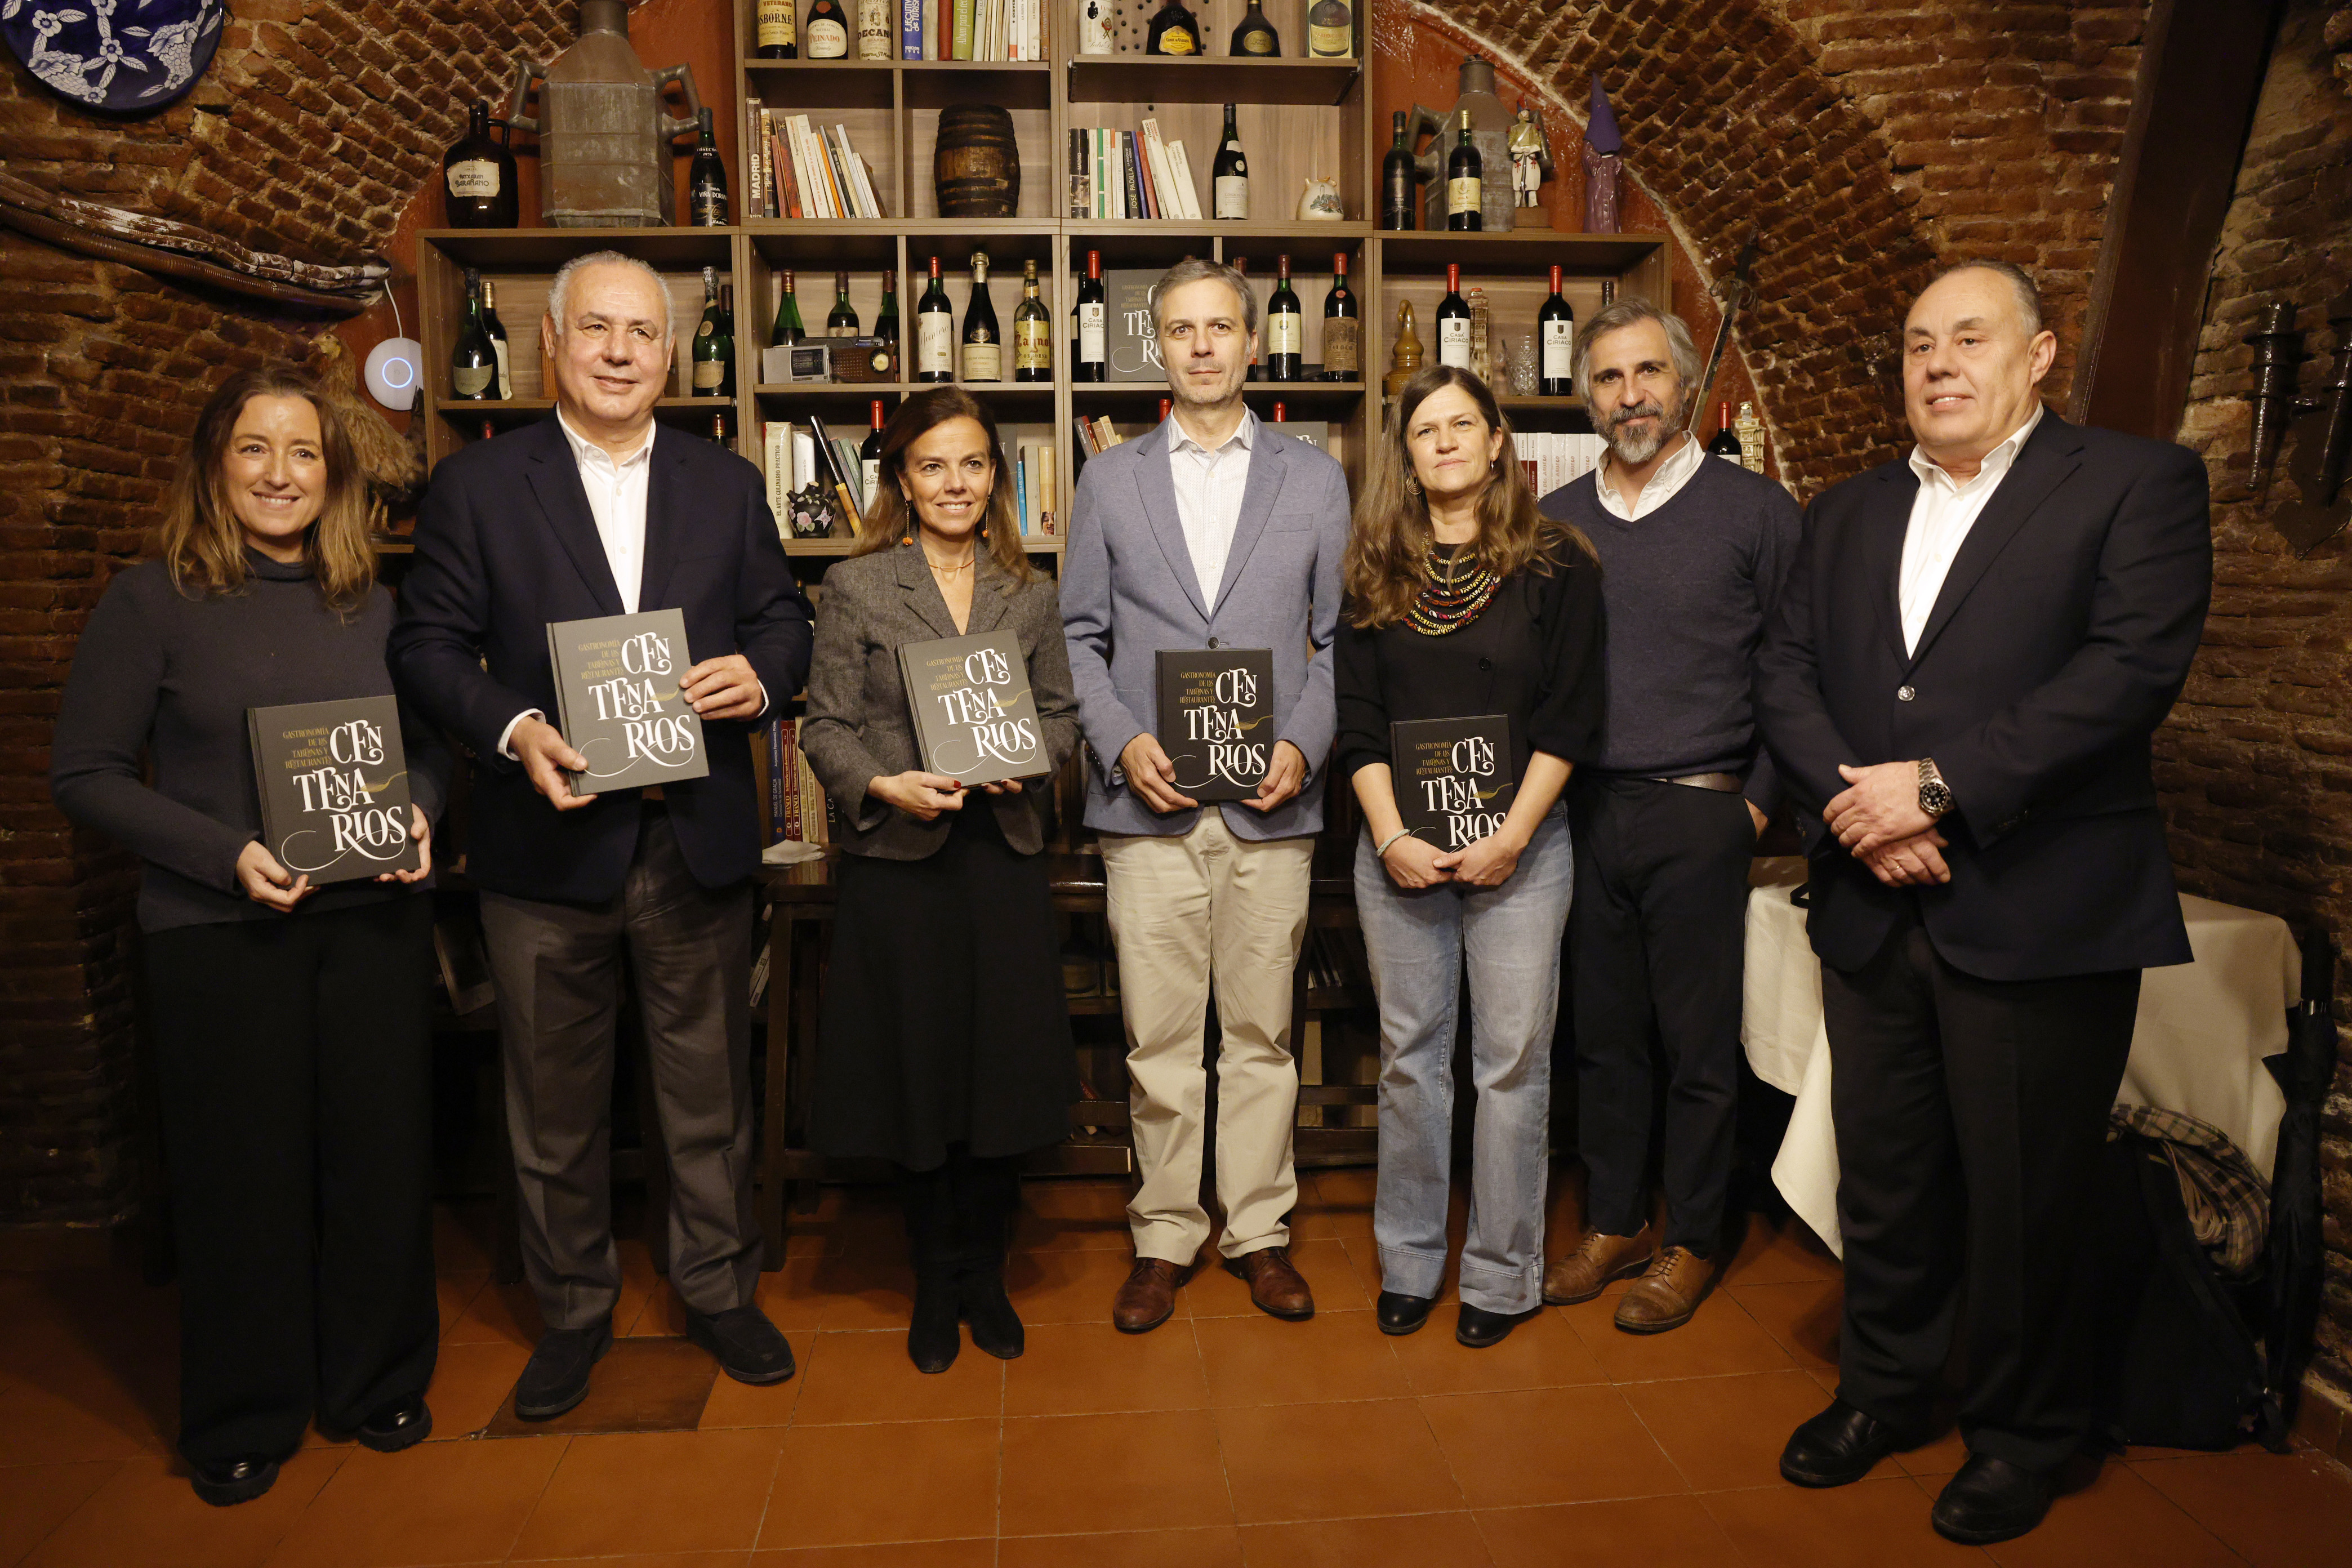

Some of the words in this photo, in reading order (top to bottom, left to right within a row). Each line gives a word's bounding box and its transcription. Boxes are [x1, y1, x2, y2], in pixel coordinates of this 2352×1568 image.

[912, 22, 920, 32] de
[959, 13, 970, 26] para
[809, 34, 840, 43] PEINADO
[957, 27, 966, 44] Album
[455, 179, 489, 188] BARAÑANO
[751, 153, 760, 198] MADRID
[1129, 193, 1137, 208] JOSÉ
[1124, 309, 1156, 338] TEN
[622, 631, 672, 675] CEN
[926, 654, 964, 667] GASTRONOMÍA
[965, 648, 1010, 685] CEN
[588, 678, 664, 721] TENA
[930, 679, 968, 691] RESTAURANTES
[1215, 667, 1257, 707] CEN
[938, 687, 1006, 725] TENA
[1180, 696, 1215, 704] RESTAURANTES
[283, 727, 329, 739] GASTRONOMÍA
[1184, 705, 1244, 744] TENA
[308, 738, 316, 746] DE
[329, 719, 384, 765] CEN
[622, 715, 695, 767] RIOS
[970, 718, 1036, 764] RIOS
[1415, 741, 1451, 750] GASTRONOMÍA
[285, 756, 333, 769] RESTAURANTES
[1208, 743, 1266, 787] RIOS
[1452, 736, 1494, 776] CEN
[1416, 766, 1453, 776] RESTAURANTES
[293, 767, 375, 813] TENA
[1421, 775, 1484, 814] TENA
[828, 812, 835, 822] LA
[329, 806, 406, 861] RIOS
